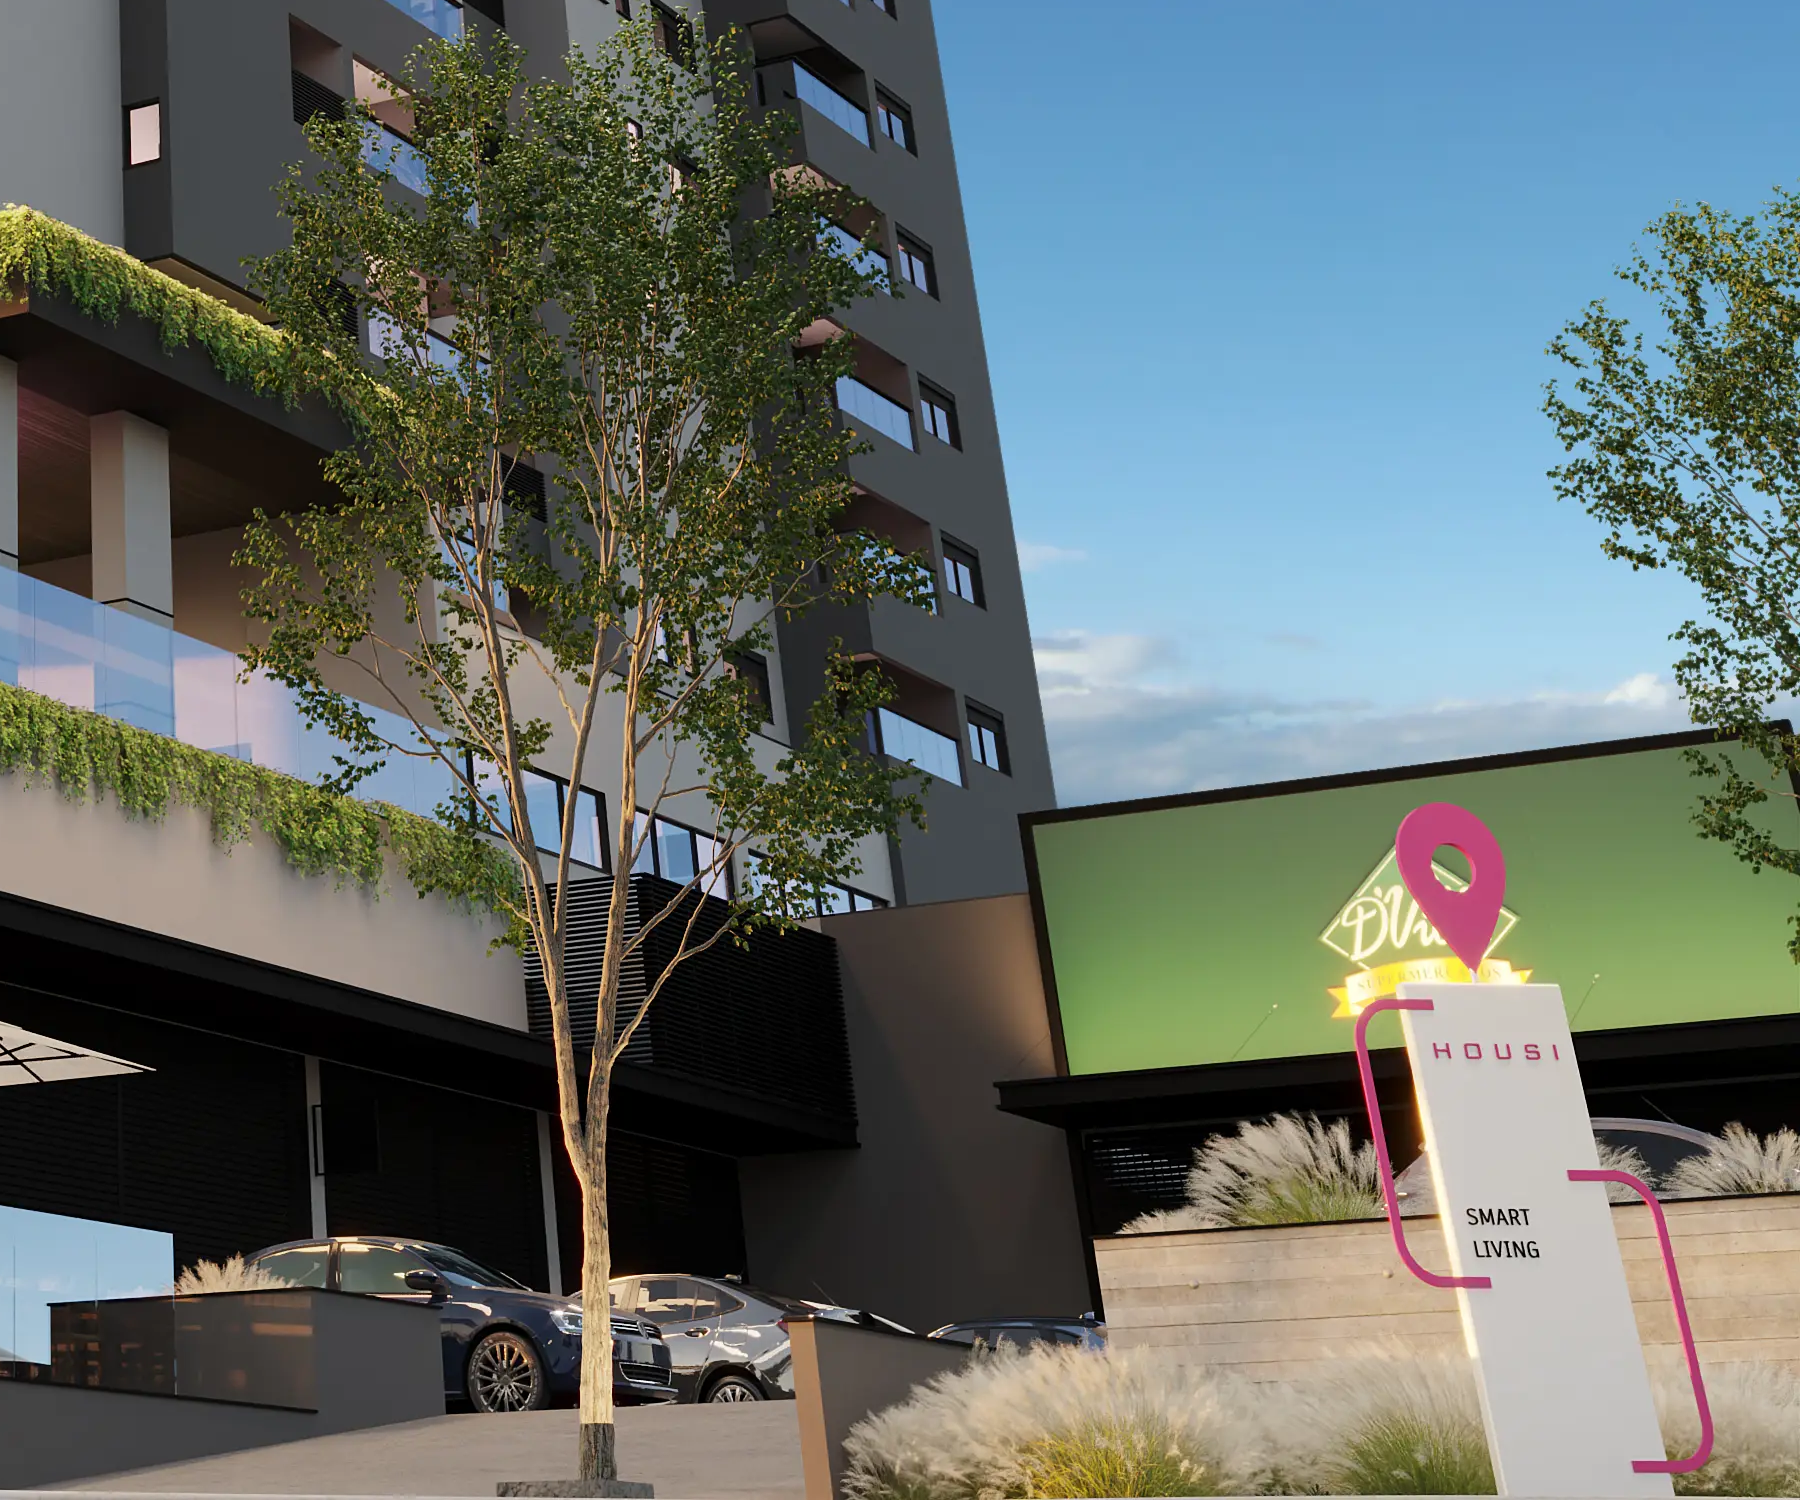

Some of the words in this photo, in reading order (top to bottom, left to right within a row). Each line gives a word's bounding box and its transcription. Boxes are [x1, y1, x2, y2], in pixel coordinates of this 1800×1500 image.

[1357, 964, 1502, 989] SUPERMERCAOS
[1432, 1042, 1560, 1061] HOUSI
[1466, 1207, 1530, 1226] SMART
[1472, 1240, 1540, 1259] LIVING
